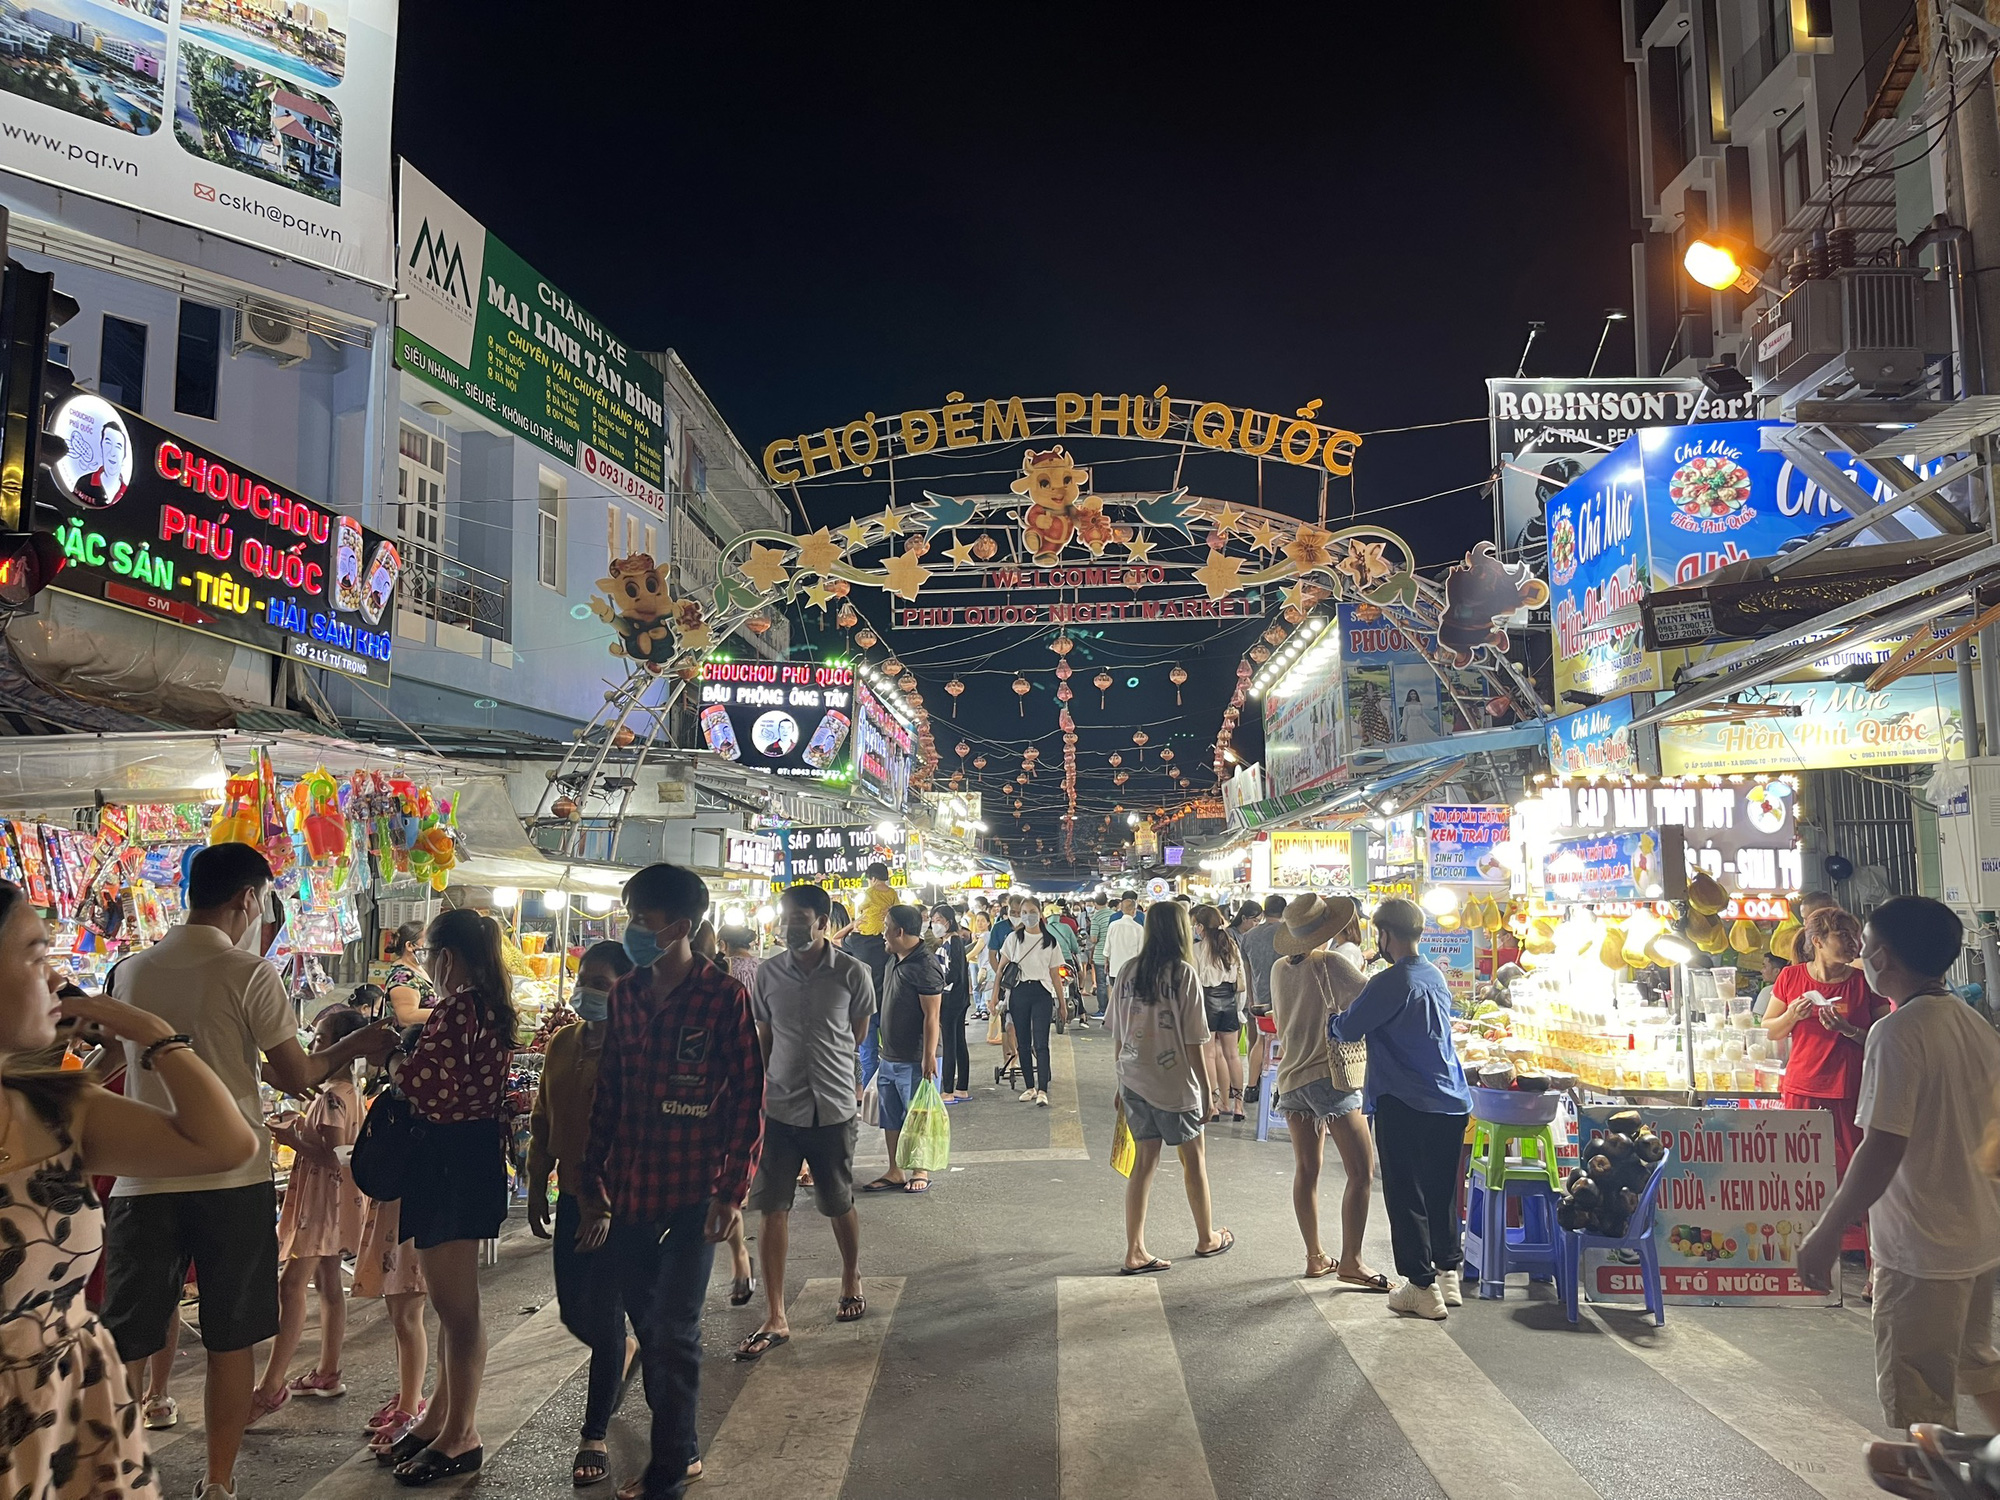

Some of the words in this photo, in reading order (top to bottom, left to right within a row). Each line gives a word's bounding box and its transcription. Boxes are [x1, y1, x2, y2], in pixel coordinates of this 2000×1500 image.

[2, 120, 139, 178] www.pqr.vn
[218, 189, 343, 245] cskh@pqr.vn
[537, 282, 604, 348] CHÀNH
[606, 334, 628, 368] XE
[487, 276, 530, 331] MAI
[533, 311, 581, 368] LINH
[584, 350, 622, 398] TÂN
[624, 380, 663, 428] BÌNH
[495, 343, 508, 358] PHÚ
[508, 352, 526, 371] QUỐC
[495, 371, 504, 385] HÀ
[505, 364, 519, 380] HCM
[507, 330, 549, 369] CHUYÊN
[552, 359, 571, 385] VẬN
[610, 400, 633, 425] HÀNG
[634, 417, 650, 439] HÓA
[403, 344, 426, 370] SIÊU
[427, 358, 459, 390] NHANH
[465, 381, 485, 405] SIÊU
[485, 391, 497, 412] RẺ
[502, 404, 529, 431] KHÔNG
[530, 422, 539, 437] LO
[554, 433, 574, 458] HÀNG
[1498, 391, 1664, 421] ROBINSON
[763, 410, 880, 483] CHỢ
[900, 390, 1030, 456] ĐÊM
[1055, 385, 1171, 440] PHÚ
[1193, 398, 1364, 478] QUỐC
[1674, 440, 1703, 463] Chả
[1706, 440, 1743, 460] Mực
[155, 440, 330, 546] CHOUCHOU
[1578, 491, 1601, 565] Chả
[1603, 481, 1634, 557] Mực
[1671, 511, 1701, 533] Hiền
[1701, 517, 1727, 534] Phú
[1726, 504, 1758, 530] Quốc
[159, 503, 235, 562] PHÚ
[242, 537, 324, 597] QUỐC
[991, 566, 1124, 590] WELCOME
[1133, 565, 1166, 584] TO
[110, 541, 175, 592] SẢN
[196, 570, 251, 615] TIÊU
[266, 596, 308, 635] HẢI
[311, 610, 354, 652] SẢN
[354, 629, 392, 662] KHÔ
[147, 595, 171, 612] 5M
[902, 606, 954, 628] PHU
[964, 604, 1038, 626] QUOC
[1049, 600, 1130, 624] NIGHT
[1141, 598, 1253, 620] MARKET
[1657, 613, 1687, 626] MINH
[295, 642, 309, 656] SỐ
[309, 648, 315, 659] 2
[317, 649, 328, 662] LÝ
[329, 653, 341, 668] TỰ
[342, 658, 368, 675] TRỌNG
[702, 663, 777, 683] CHOUCHOU
[782, 664, 810, 684] PHÚ
[815, 664, 854, 687] QUỐC
[702, 685, 731, 705] ĐẬU
[736, 685, 784, 708] PHỘNG
[788, 685, 819, 707] ÔNG
[823, 690, 849, 708] TÂY
[1823, 685, 1893, 717] Mực
[1571, 714, 1588, 740] Chả
[1590, 710, 1612, 737] Mực
[1717, 722, 1785, 752] Hiền
[1854, 713, 1931, 747] Quốc
[787, 830, 812, 850] SÁP
[849, 825, 877, 846] THỐT
[1431, 828, 1457, 843] KEM
[1461, 826, 1489, 843] TRÁI
[791, 855, 818, 876] TRÁI
[892, 854, 907, 870] ÉP
[1433, 865, 1449, 877] CÁC
[1434, 852, 1452, 863] SINH
[1454, 850, 1465, 863] TỐ
[838, 876, 862, 889] 0336
[890, 875, 907, 888] 071
[1744, 901, 1783, 917] 004
[1557, 1145, 1578, 1158] KEM
[1680, 1116, 1724, 1163] DẦM
[1728, 1119, 1778, 1164] THỐT
[1785, 1119, 1822, 1164] NỐT
[1673, 1171, 1706, 1211] DỪA
[1720, 1179, 1755, 1212] KEM
[1759, 1171, 1791, 1212] DỪA
[1795, 1171, 1826, 1212] SÁP
[1675, 1271, 1709, 1292] TỐ
[1717, 1271, 1780, 1292] NƯỚC
[1787, 1271, 1813, 1292] É
